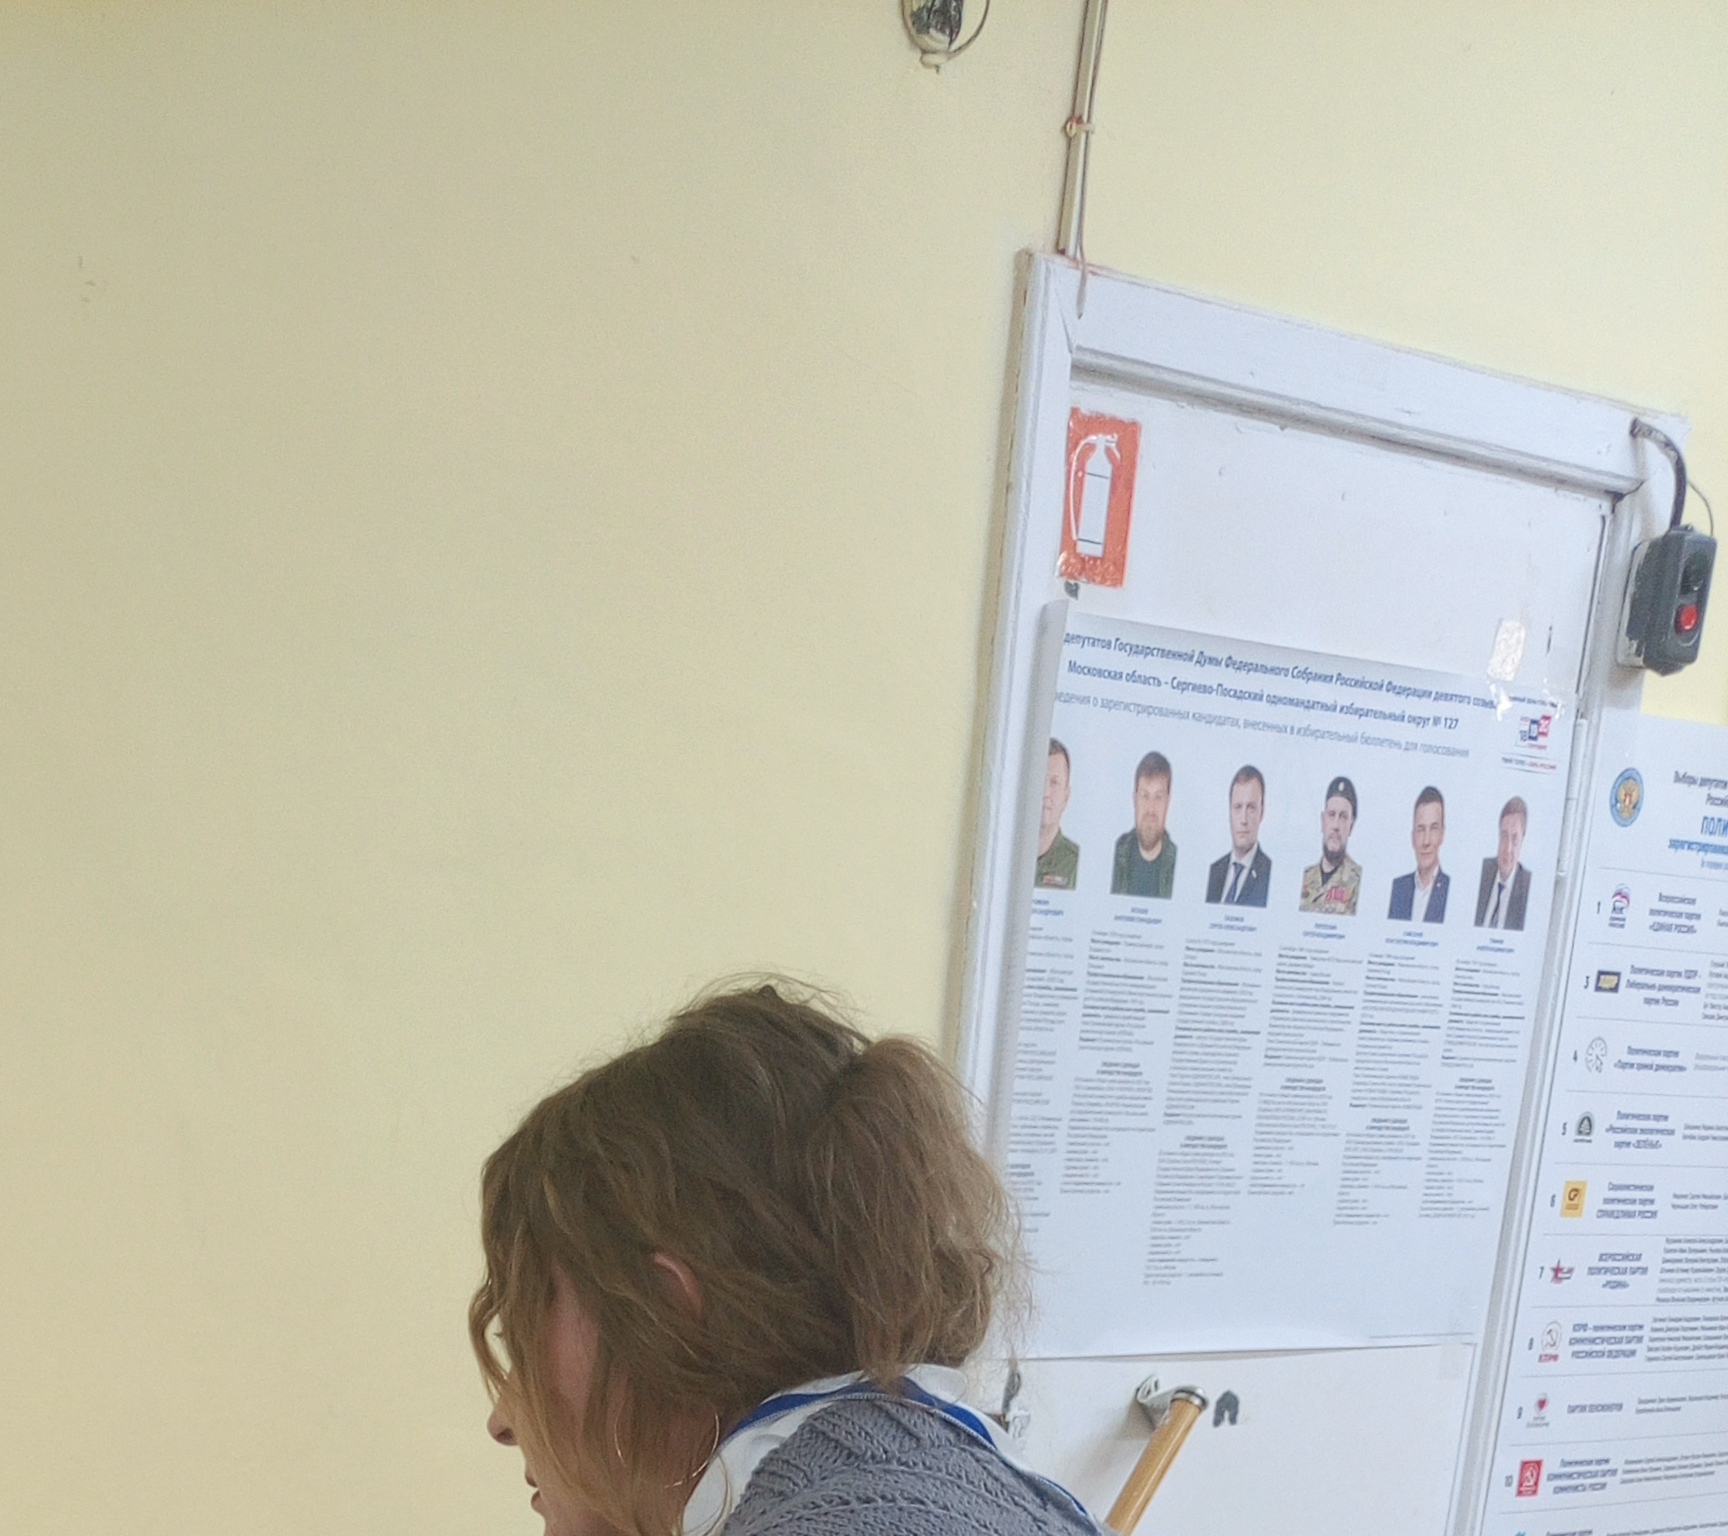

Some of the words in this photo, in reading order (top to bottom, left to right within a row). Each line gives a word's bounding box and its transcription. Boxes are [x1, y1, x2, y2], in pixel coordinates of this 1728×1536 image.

[1067, 660, 1123, 680] Московская
[1125, 668, 1162, 687] область
[1171, 677, 1264, 701] Сергиево-Посадский
[1266, 693, 1337, 713] одномандатный
[1339, 701, 1405, 723] избирательный
[1408, 714, 1431, 727] округ
[1444, 717, 1459, 730] 127
[1113, 637, 1195, 663] Государственной
[1194, 650, 1223, 668] Думы
[1224, 655, 1290, 679] Федерального
[1291, 665, 1334, 686] Собрания
[1335, 672, 1384, 692] Российской
[1385, 679, 1432, 701] Федерации
[1584, 975, 1590, 989] 3
